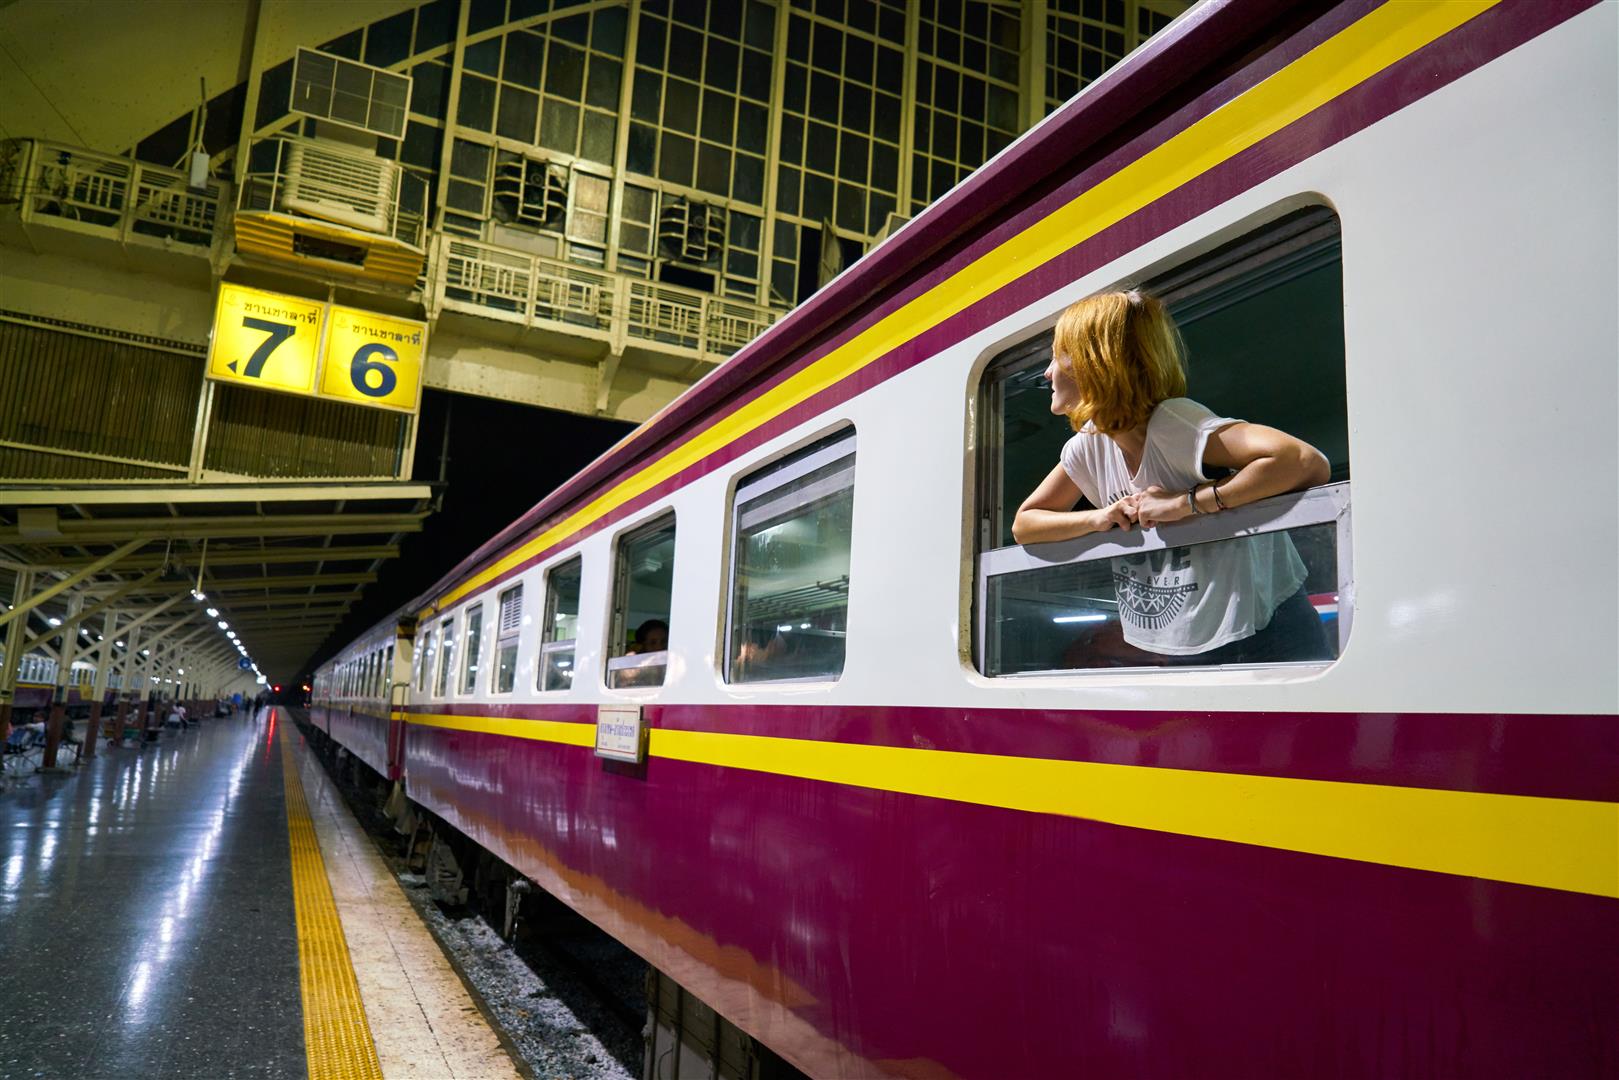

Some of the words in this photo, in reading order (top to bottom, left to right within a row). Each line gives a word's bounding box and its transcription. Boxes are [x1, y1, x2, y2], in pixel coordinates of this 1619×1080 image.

[243, 302, 318, 326] ชานชาลาที่
[352, 322, 421, 346] ชานชาลาที่
[242, 316, 297, 379] 7
[350, 343, 399, 398] 6
[1146, 575, 1180, 587] EVER
